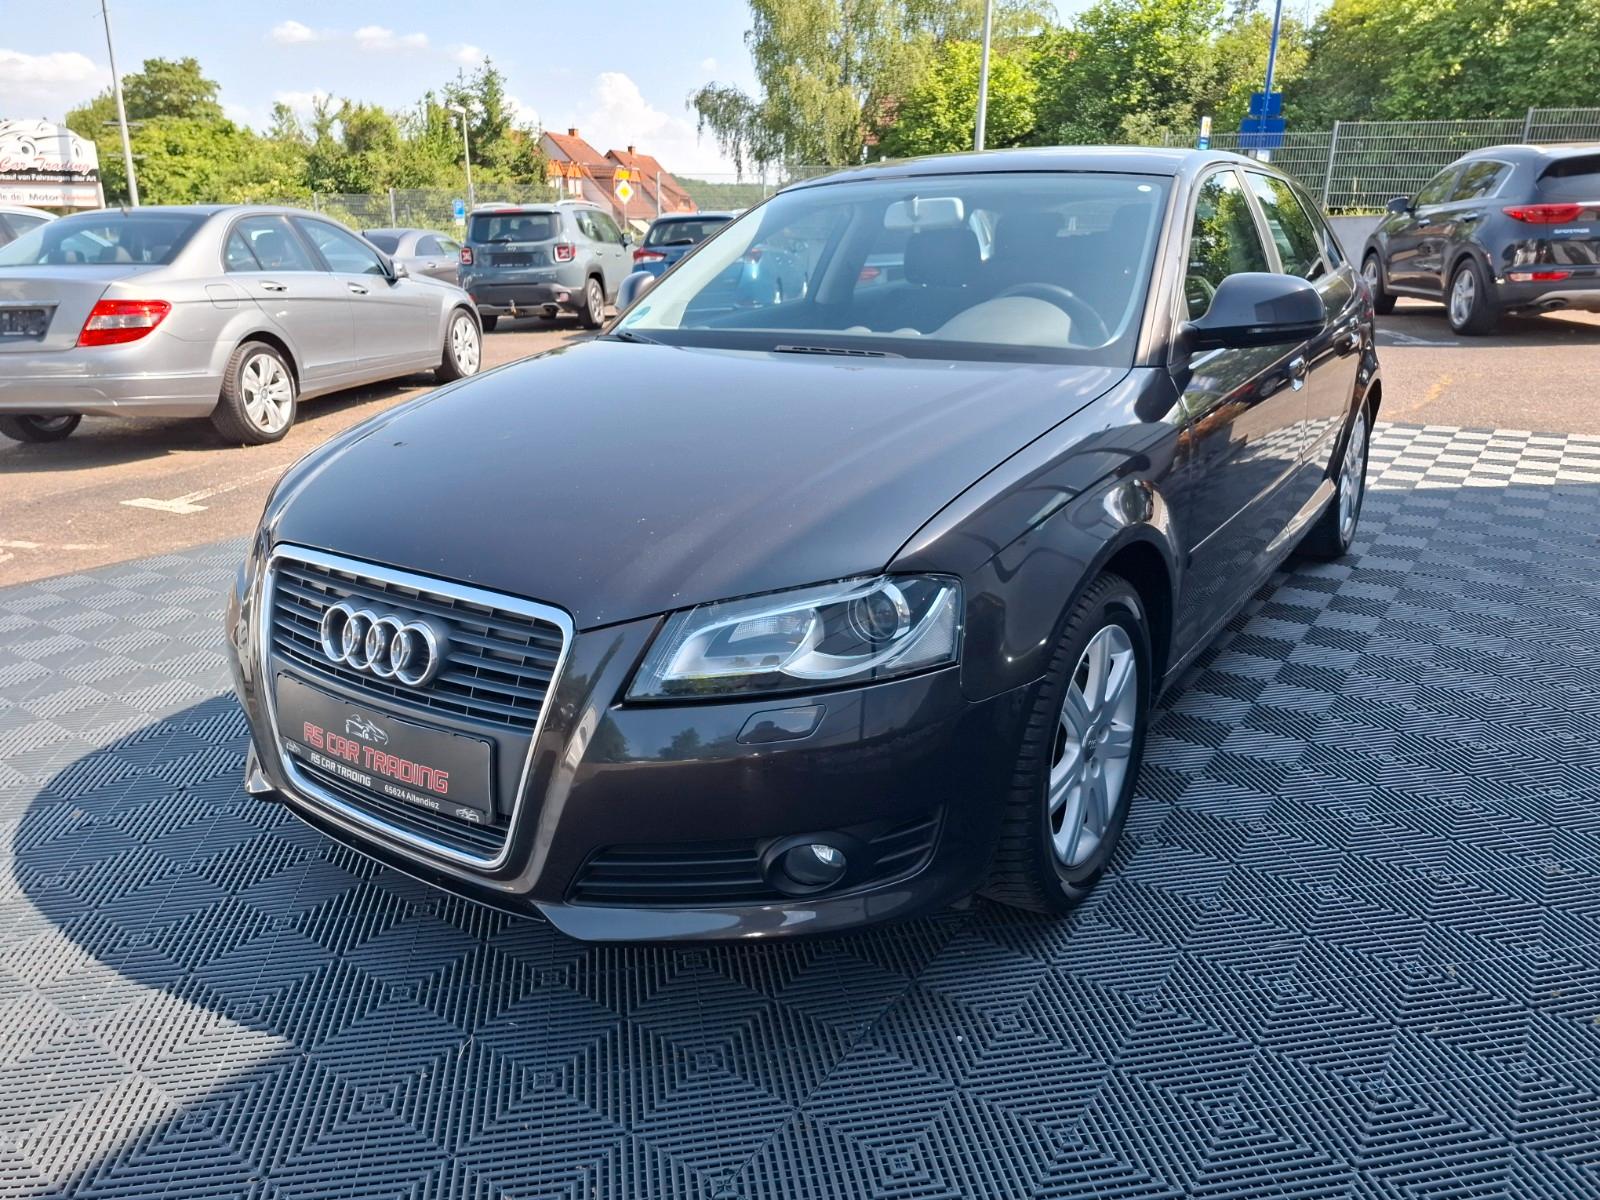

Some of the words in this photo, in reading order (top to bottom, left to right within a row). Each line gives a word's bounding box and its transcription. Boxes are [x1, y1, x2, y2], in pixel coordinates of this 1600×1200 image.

[33, 156, 91, 176] Trading
[303, 721, 324, 749] RS
[326, 731, 360, 764] CAR
[362, 745, 449, 794] TRADING
[310, 752, 321, 765] RS
[321, 758, 336, 772] CAR
[337, 764, 372, 787] TRADING
[384, 784, 406, 799] 65624
[405, 791, 440, 810] Altendiez
